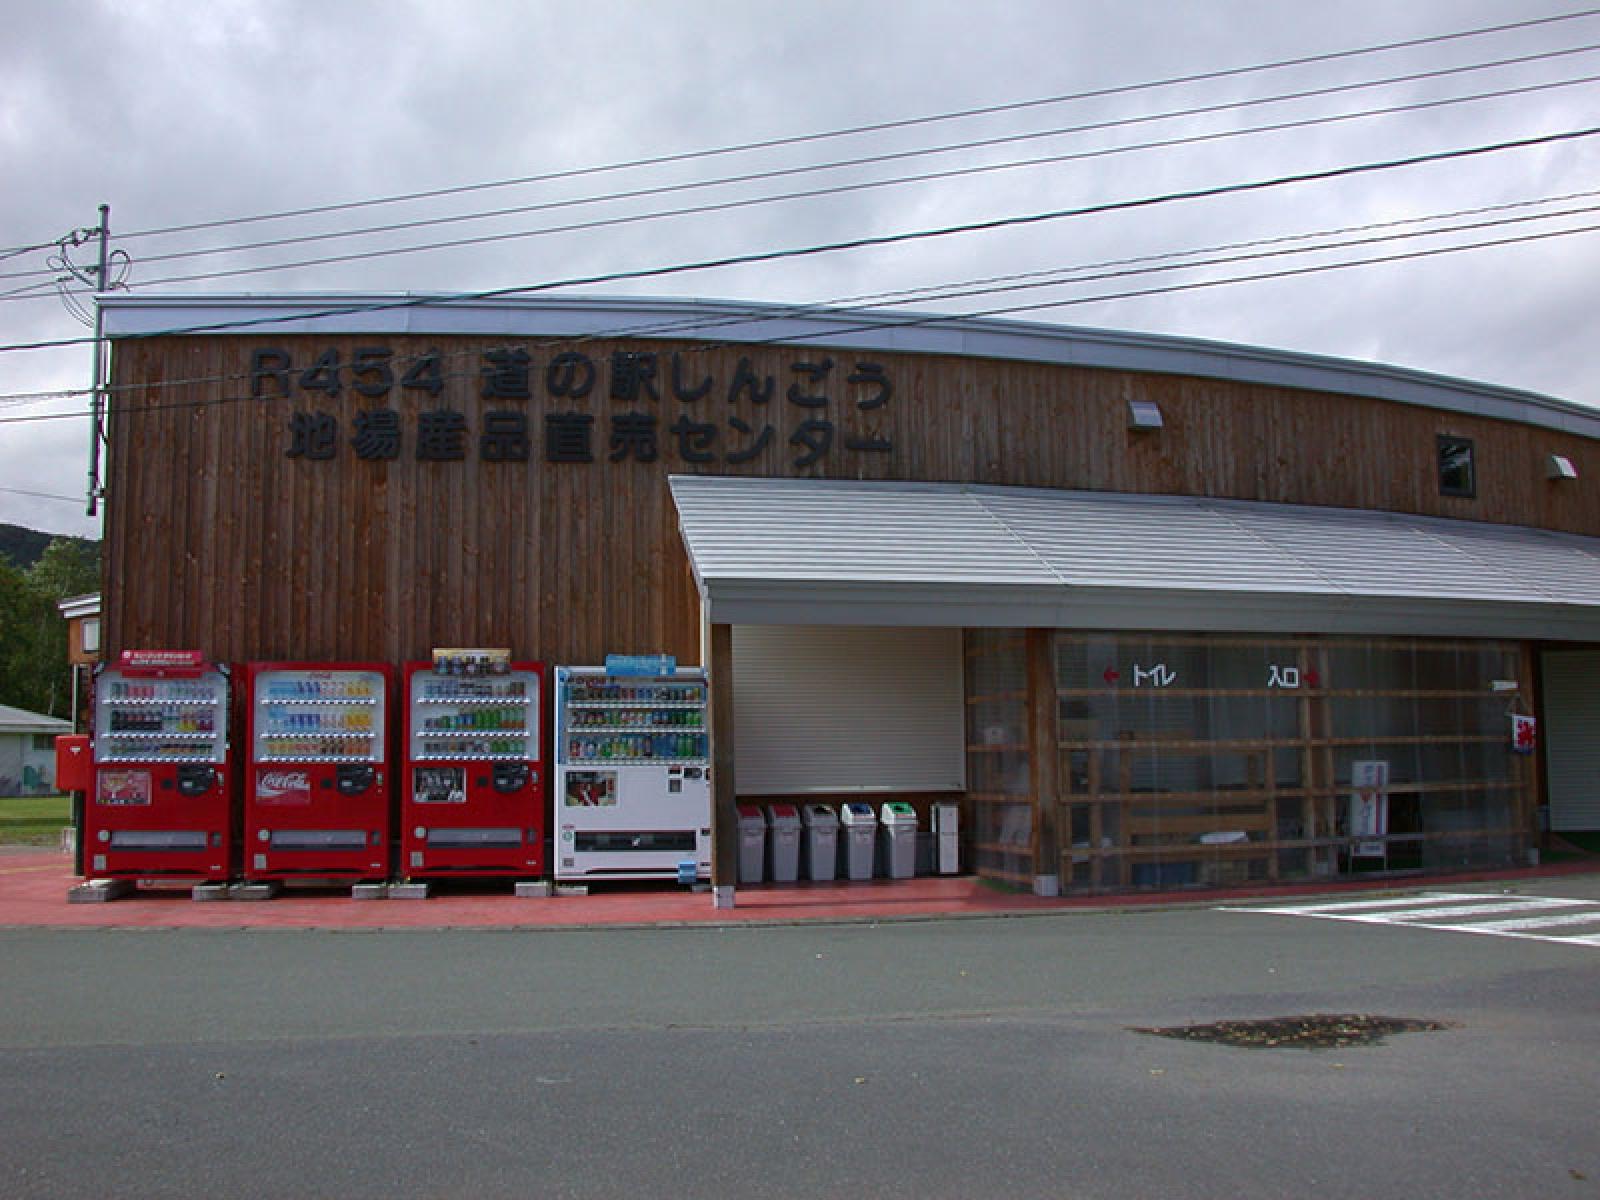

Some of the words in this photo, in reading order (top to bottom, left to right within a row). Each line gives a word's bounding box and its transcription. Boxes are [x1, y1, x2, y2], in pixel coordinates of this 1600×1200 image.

[252, 347, 445, 398] R454
[480, 346, 893, 411] 道の駅しんごう
[286, 409, 894, 468] 地場産品直売センター
[1133, 663, 1176, 687] トイレ
[1267, 665, 1299, 689] 入口
